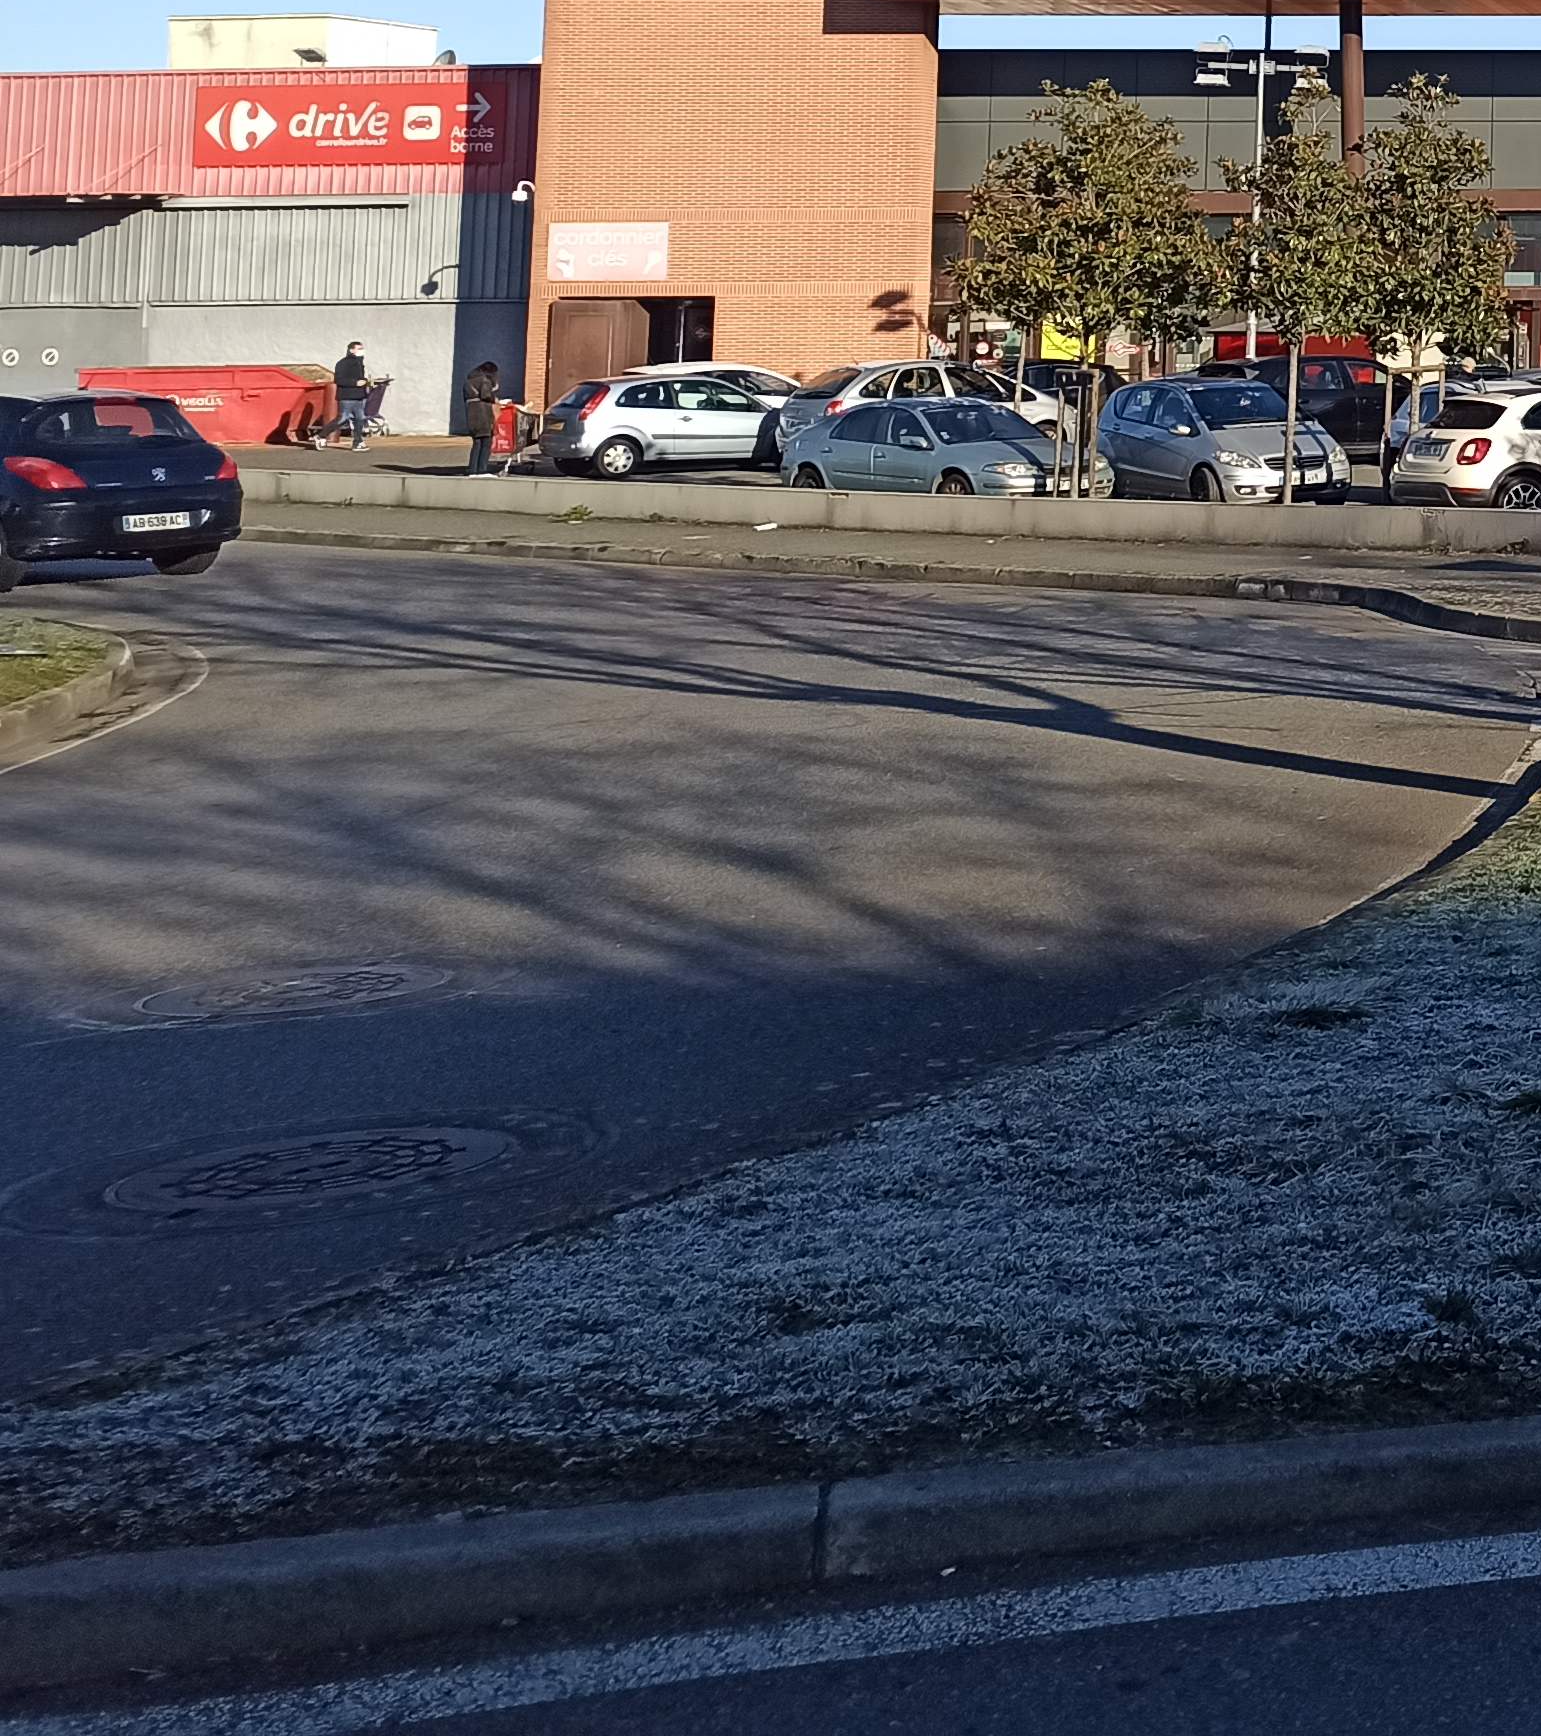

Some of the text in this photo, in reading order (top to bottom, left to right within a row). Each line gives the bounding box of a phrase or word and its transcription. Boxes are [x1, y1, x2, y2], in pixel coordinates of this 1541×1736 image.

[289, 101, 390, 138] drive
[450, 124, 495, 138] Accès
[450, 139, 494, 153] borne
[553, 227, 665, 245] cordonnier
[587, 249, 628, 266] clés
